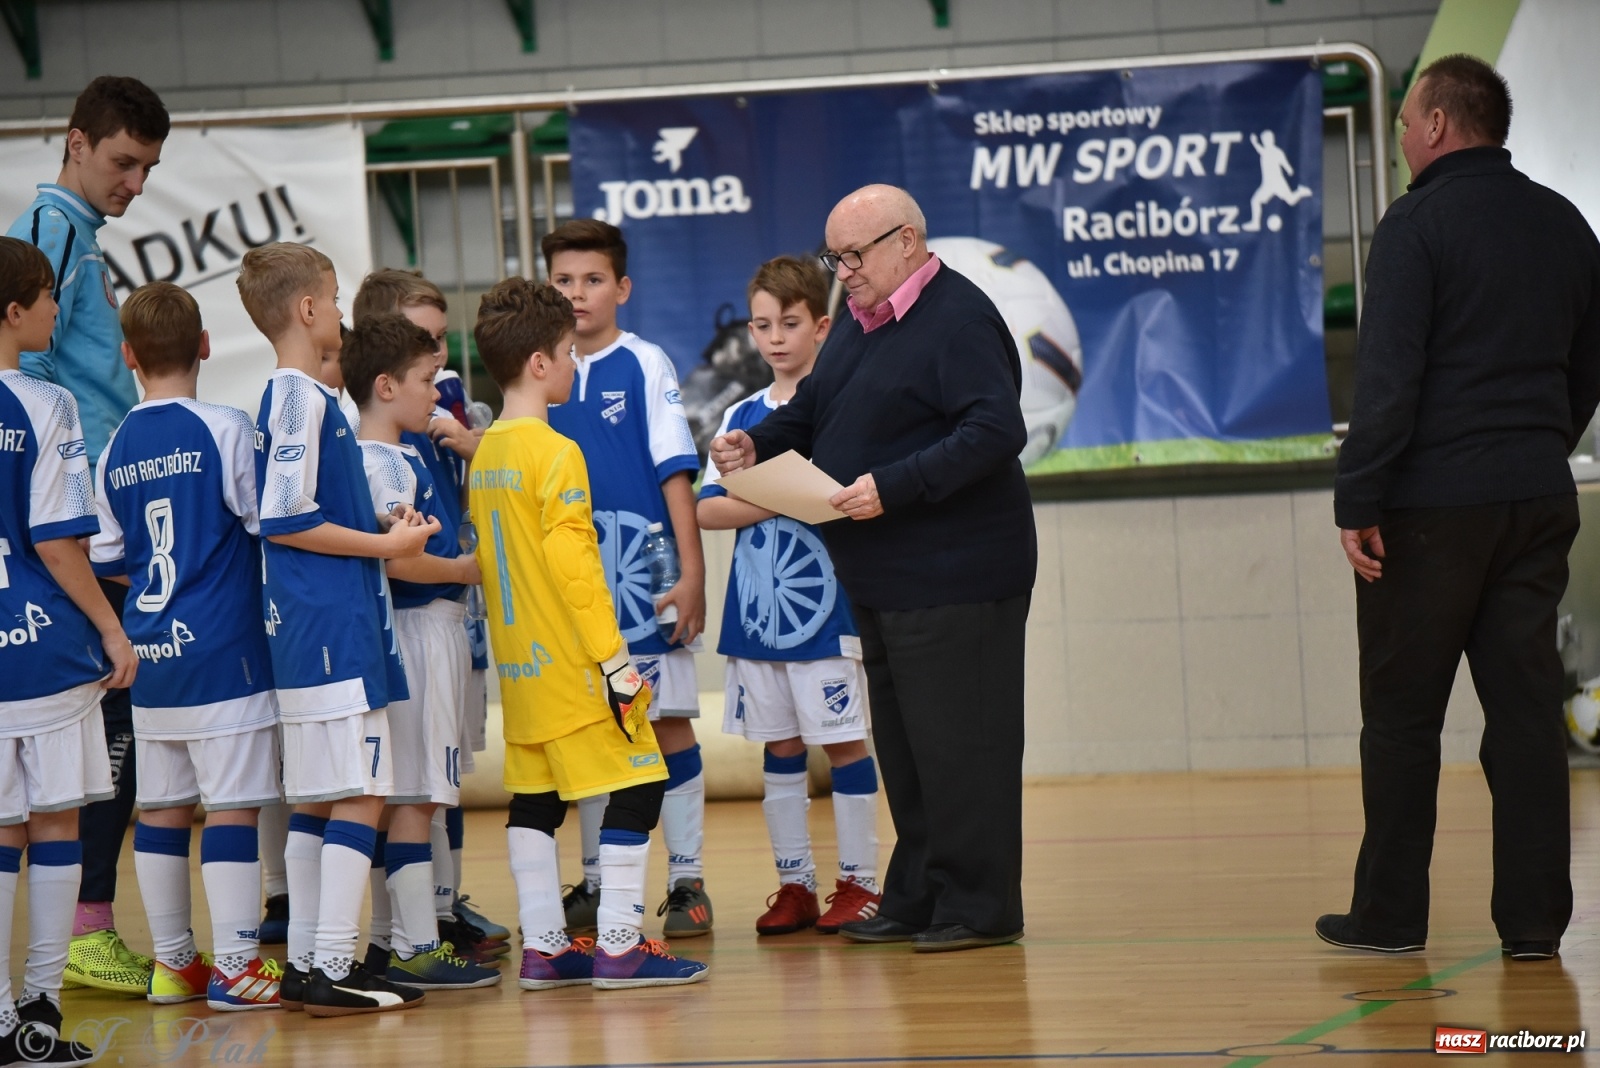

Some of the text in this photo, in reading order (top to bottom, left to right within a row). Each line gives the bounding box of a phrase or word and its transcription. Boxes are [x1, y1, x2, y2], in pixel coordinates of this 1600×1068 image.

[973, 106, 1162, 136] Sklep sportowy
[970, 131, 1243, 190] MW SPORT
[1063, 196, 1241, 242] Racibórz
[1067, 249, 1240, 278] ul. Chopina 17
[140, 448, 202, 481] RACIBÓRZ
[135, 498, 175, 613] 8
[491, 509, 515, 626] 1
[825, 689, 847, 706] UNIA
[365, 736, 381, 778] 7
